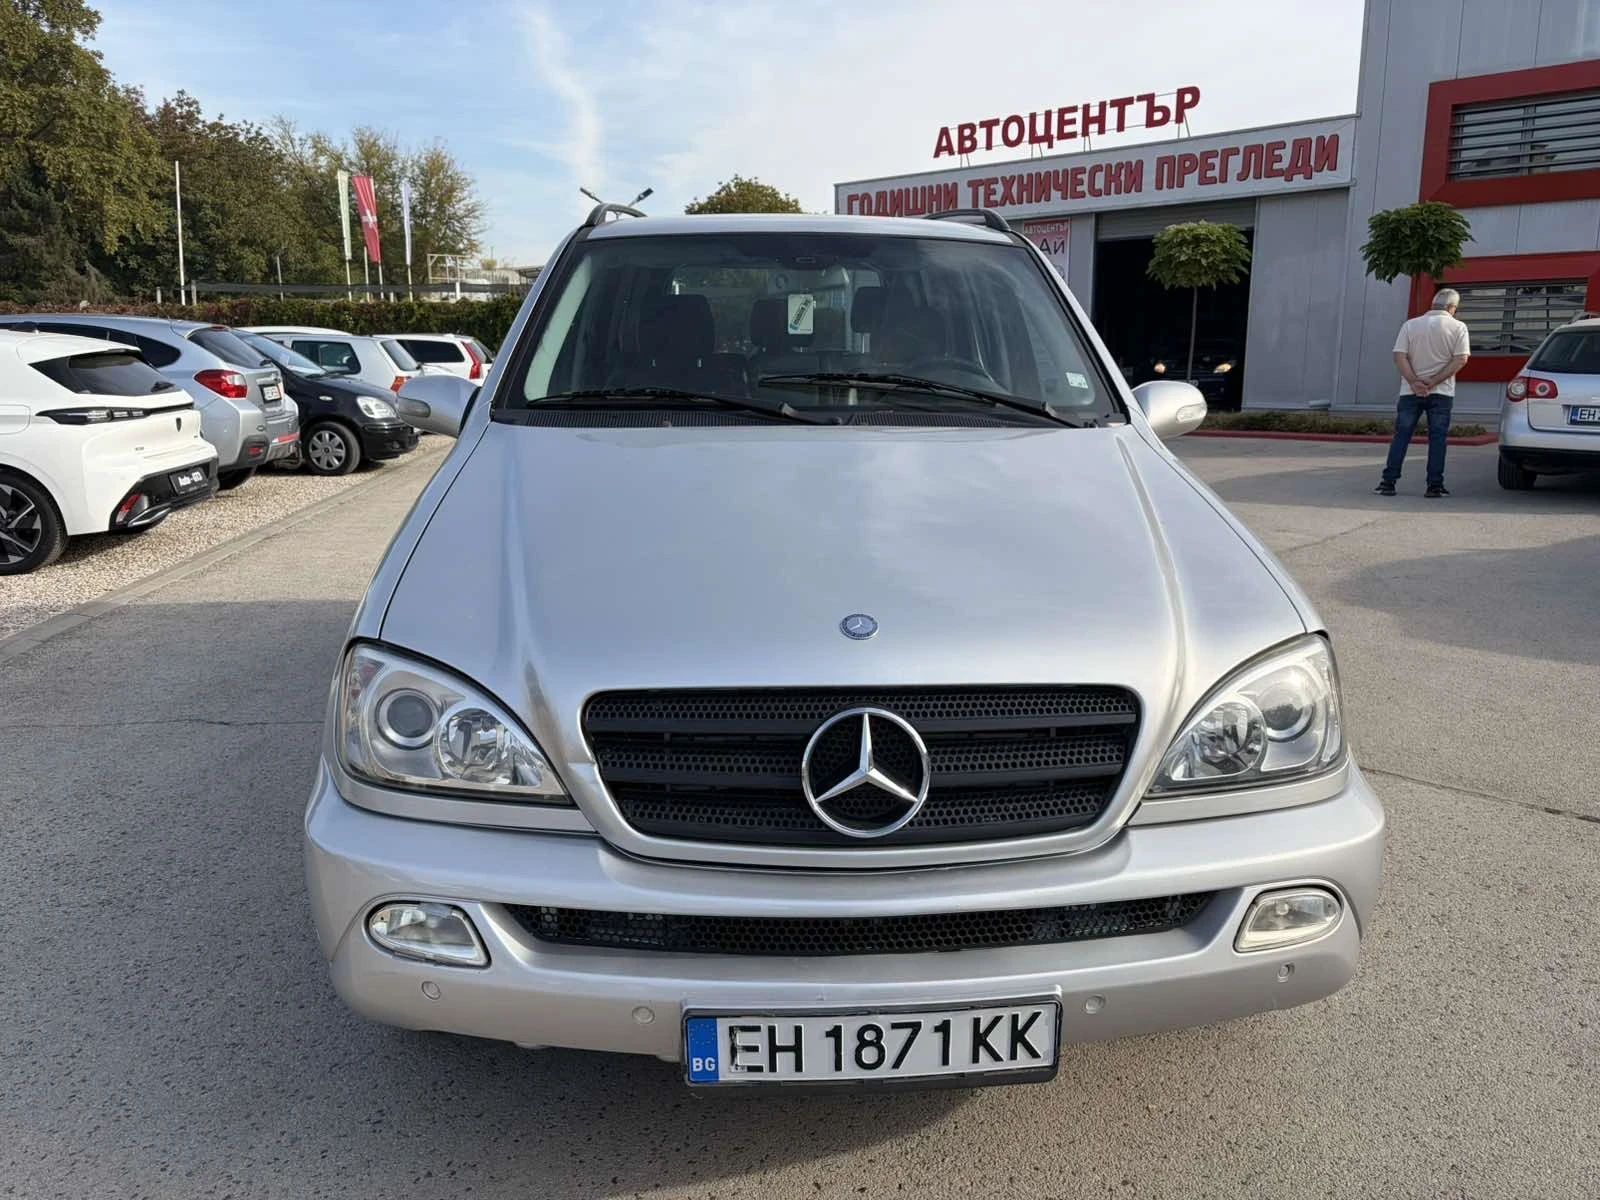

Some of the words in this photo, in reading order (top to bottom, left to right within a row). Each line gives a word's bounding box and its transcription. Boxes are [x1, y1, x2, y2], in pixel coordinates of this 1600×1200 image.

[933, 86, 1201, 158] АВТОЦЕНТЪР
[847, 182, 958, 217] ГОДИШНИ
[967, 159, 1143, 208] ТЕХНИЧЕСКИ
[1155, 134, 1339, 190] ПРЕГЛЕДИ
[692, 1057, 716, 1071] BG
[728, 1024, 805, 1073] EH
[824, 1019, 952, 1072] 1871
[971, 1011, 1043, 1064] KK
